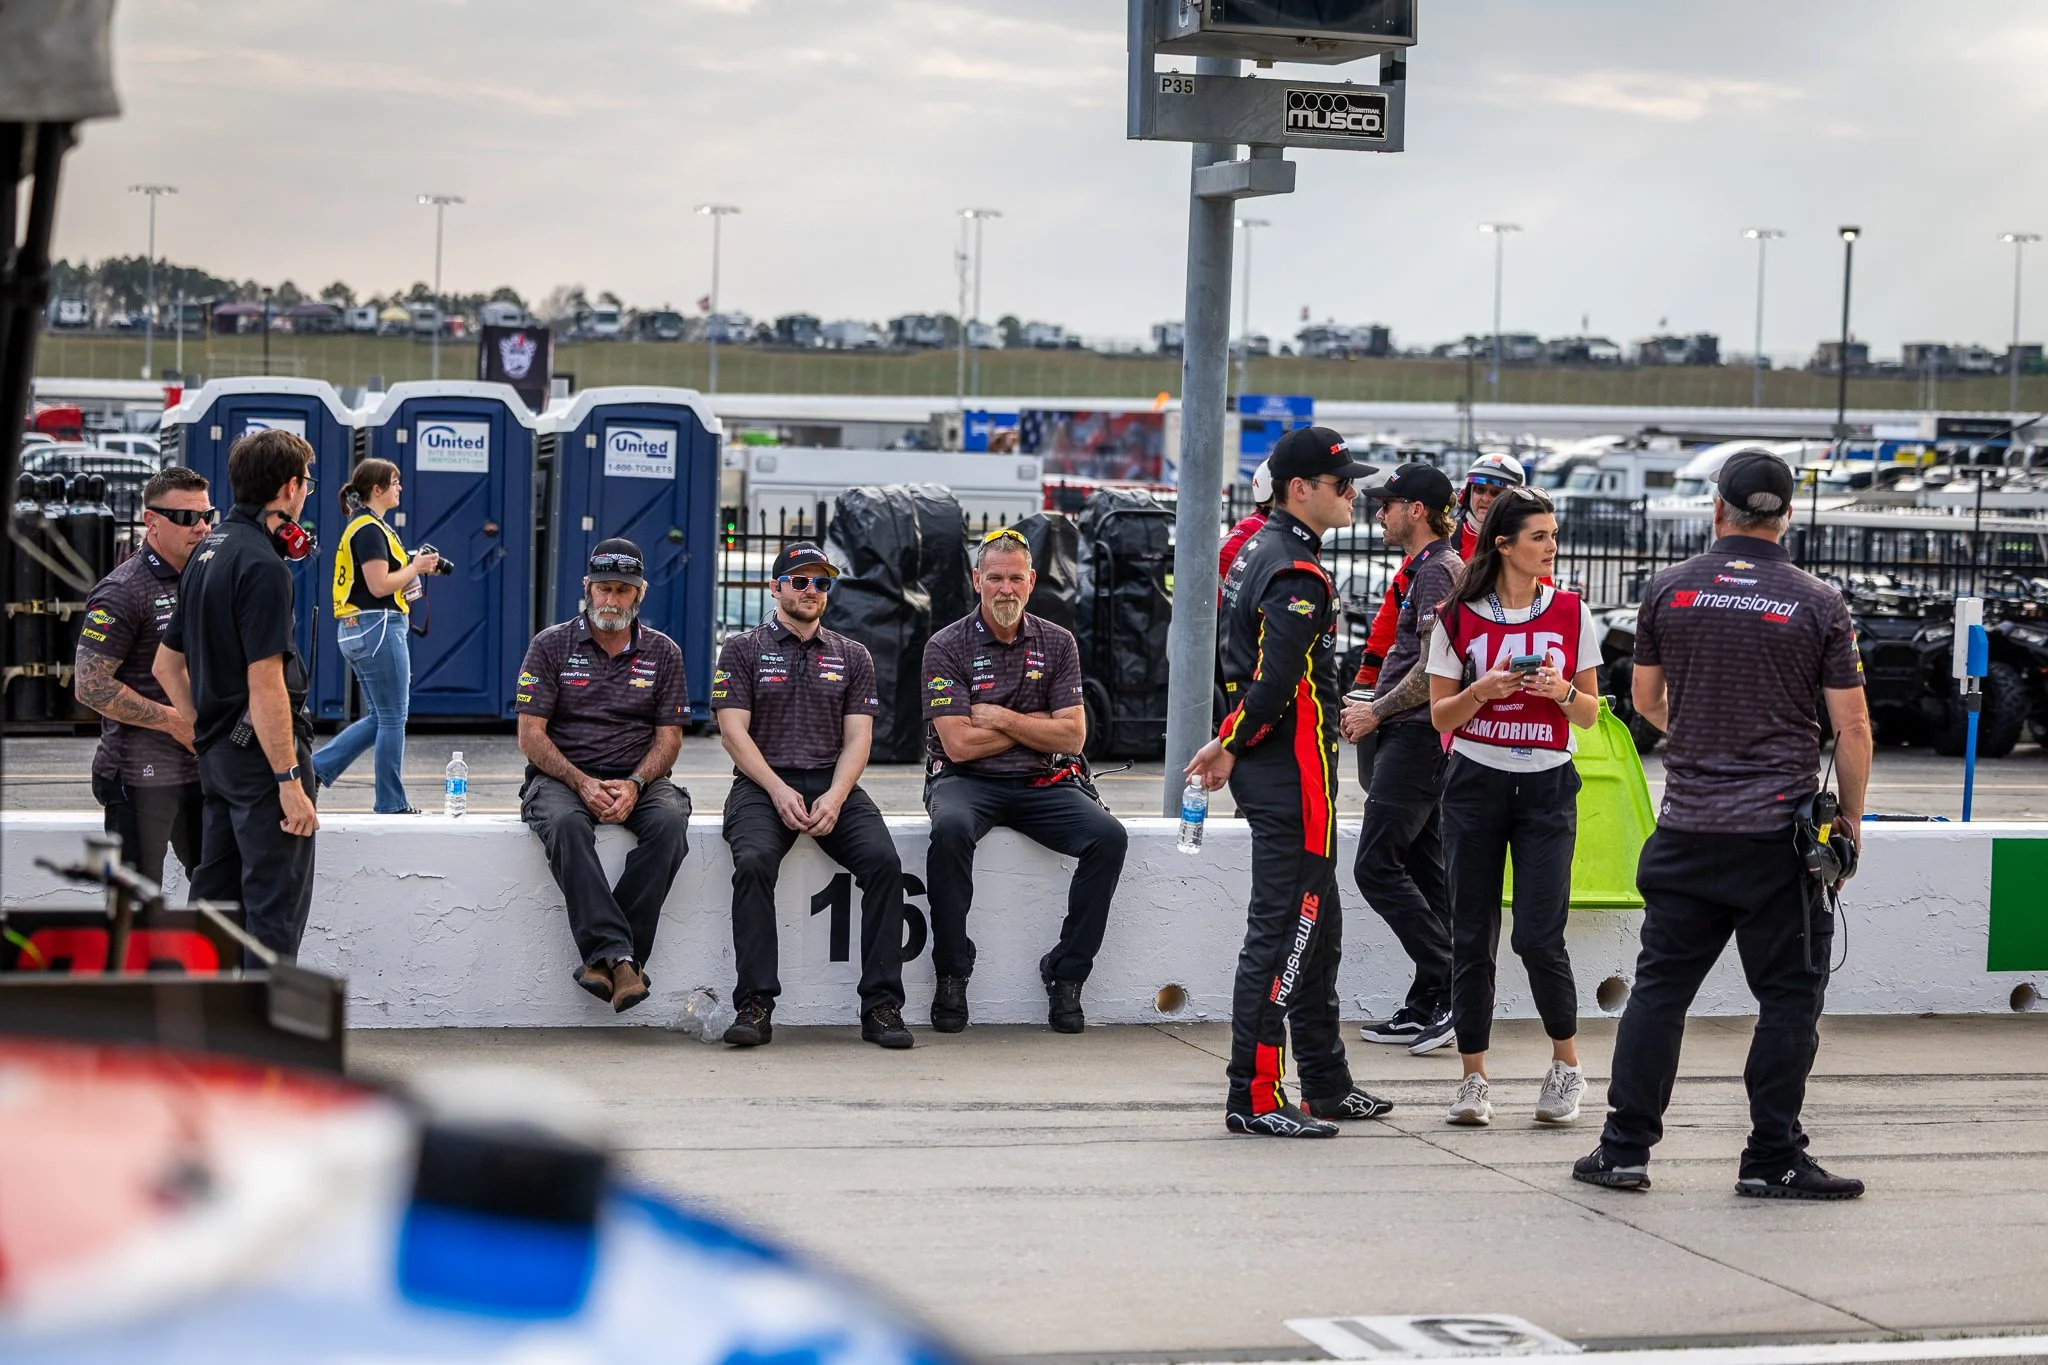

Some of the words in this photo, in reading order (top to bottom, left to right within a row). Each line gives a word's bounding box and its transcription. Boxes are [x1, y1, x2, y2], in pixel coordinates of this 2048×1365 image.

[1162, 78, 1193, 93] P35
[428, 434, 484, 449] United
[616, 438, 668, 454] United
[608, 464, 673, 474] 1-800-TOILETS
[1289, 603, 1316, 612] SUNOCO
[1530, 598, 1541, 620] NASC
[1670, 590, 1799, 617] 3Dimensional
[88, 611, 116, 625] SUNOCO
[928, 680, 953, 689] SUNOCO
[1274, 891, 1319, 1007] 3Dimensional
[1269, 976, 1281, 1002] .com
